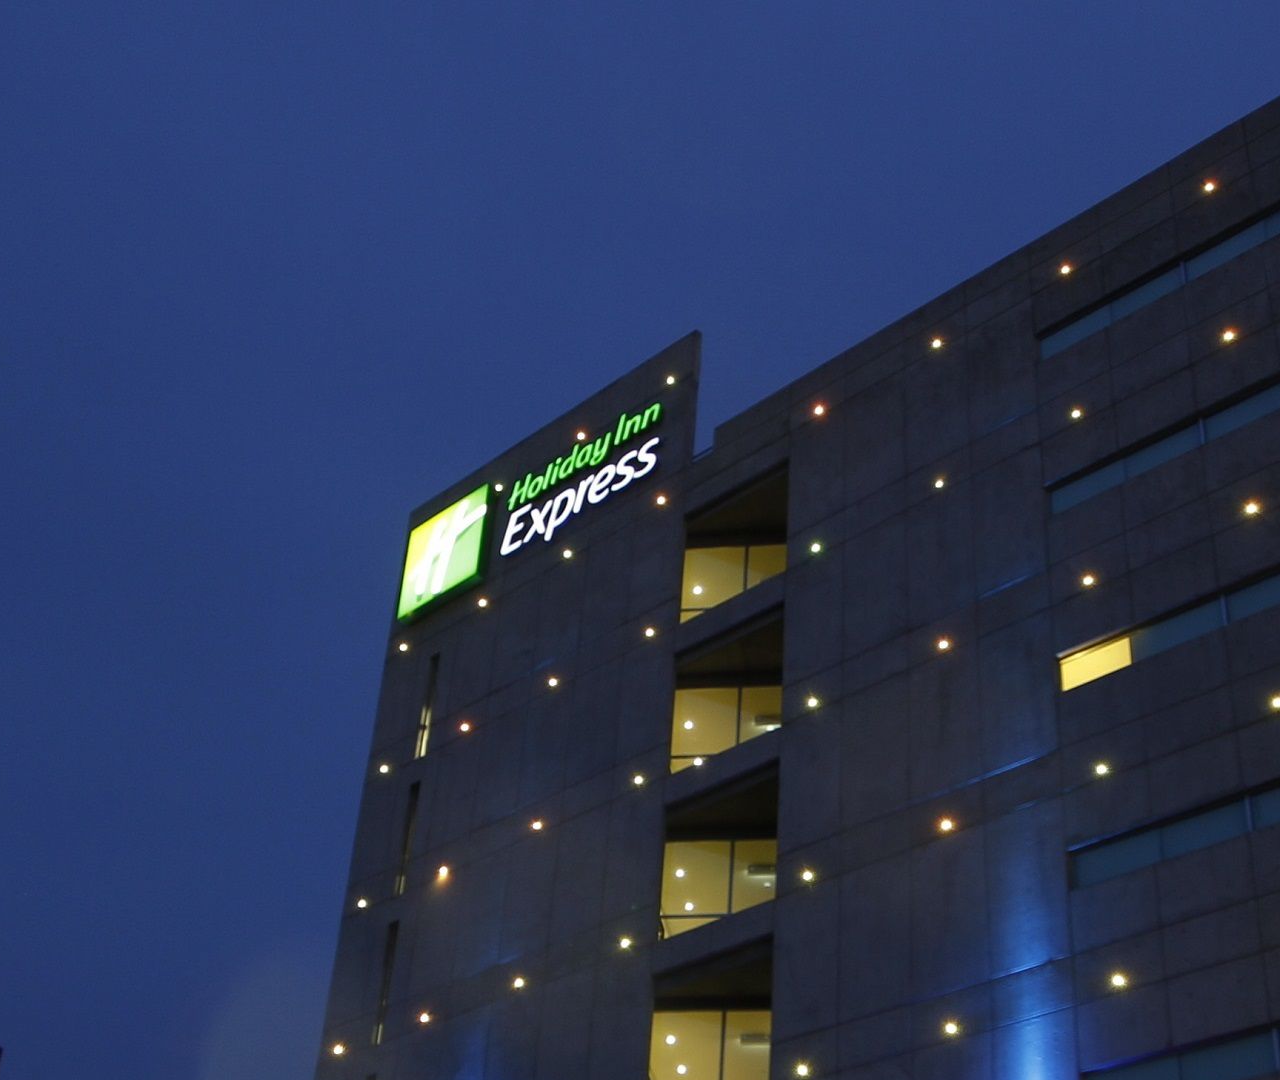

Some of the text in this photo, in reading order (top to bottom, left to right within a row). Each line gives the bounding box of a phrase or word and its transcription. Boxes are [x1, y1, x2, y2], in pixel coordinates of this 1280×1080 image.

[500, 437, 660, 556] Express
[508, 402, 661, 511] Holiday Inn
